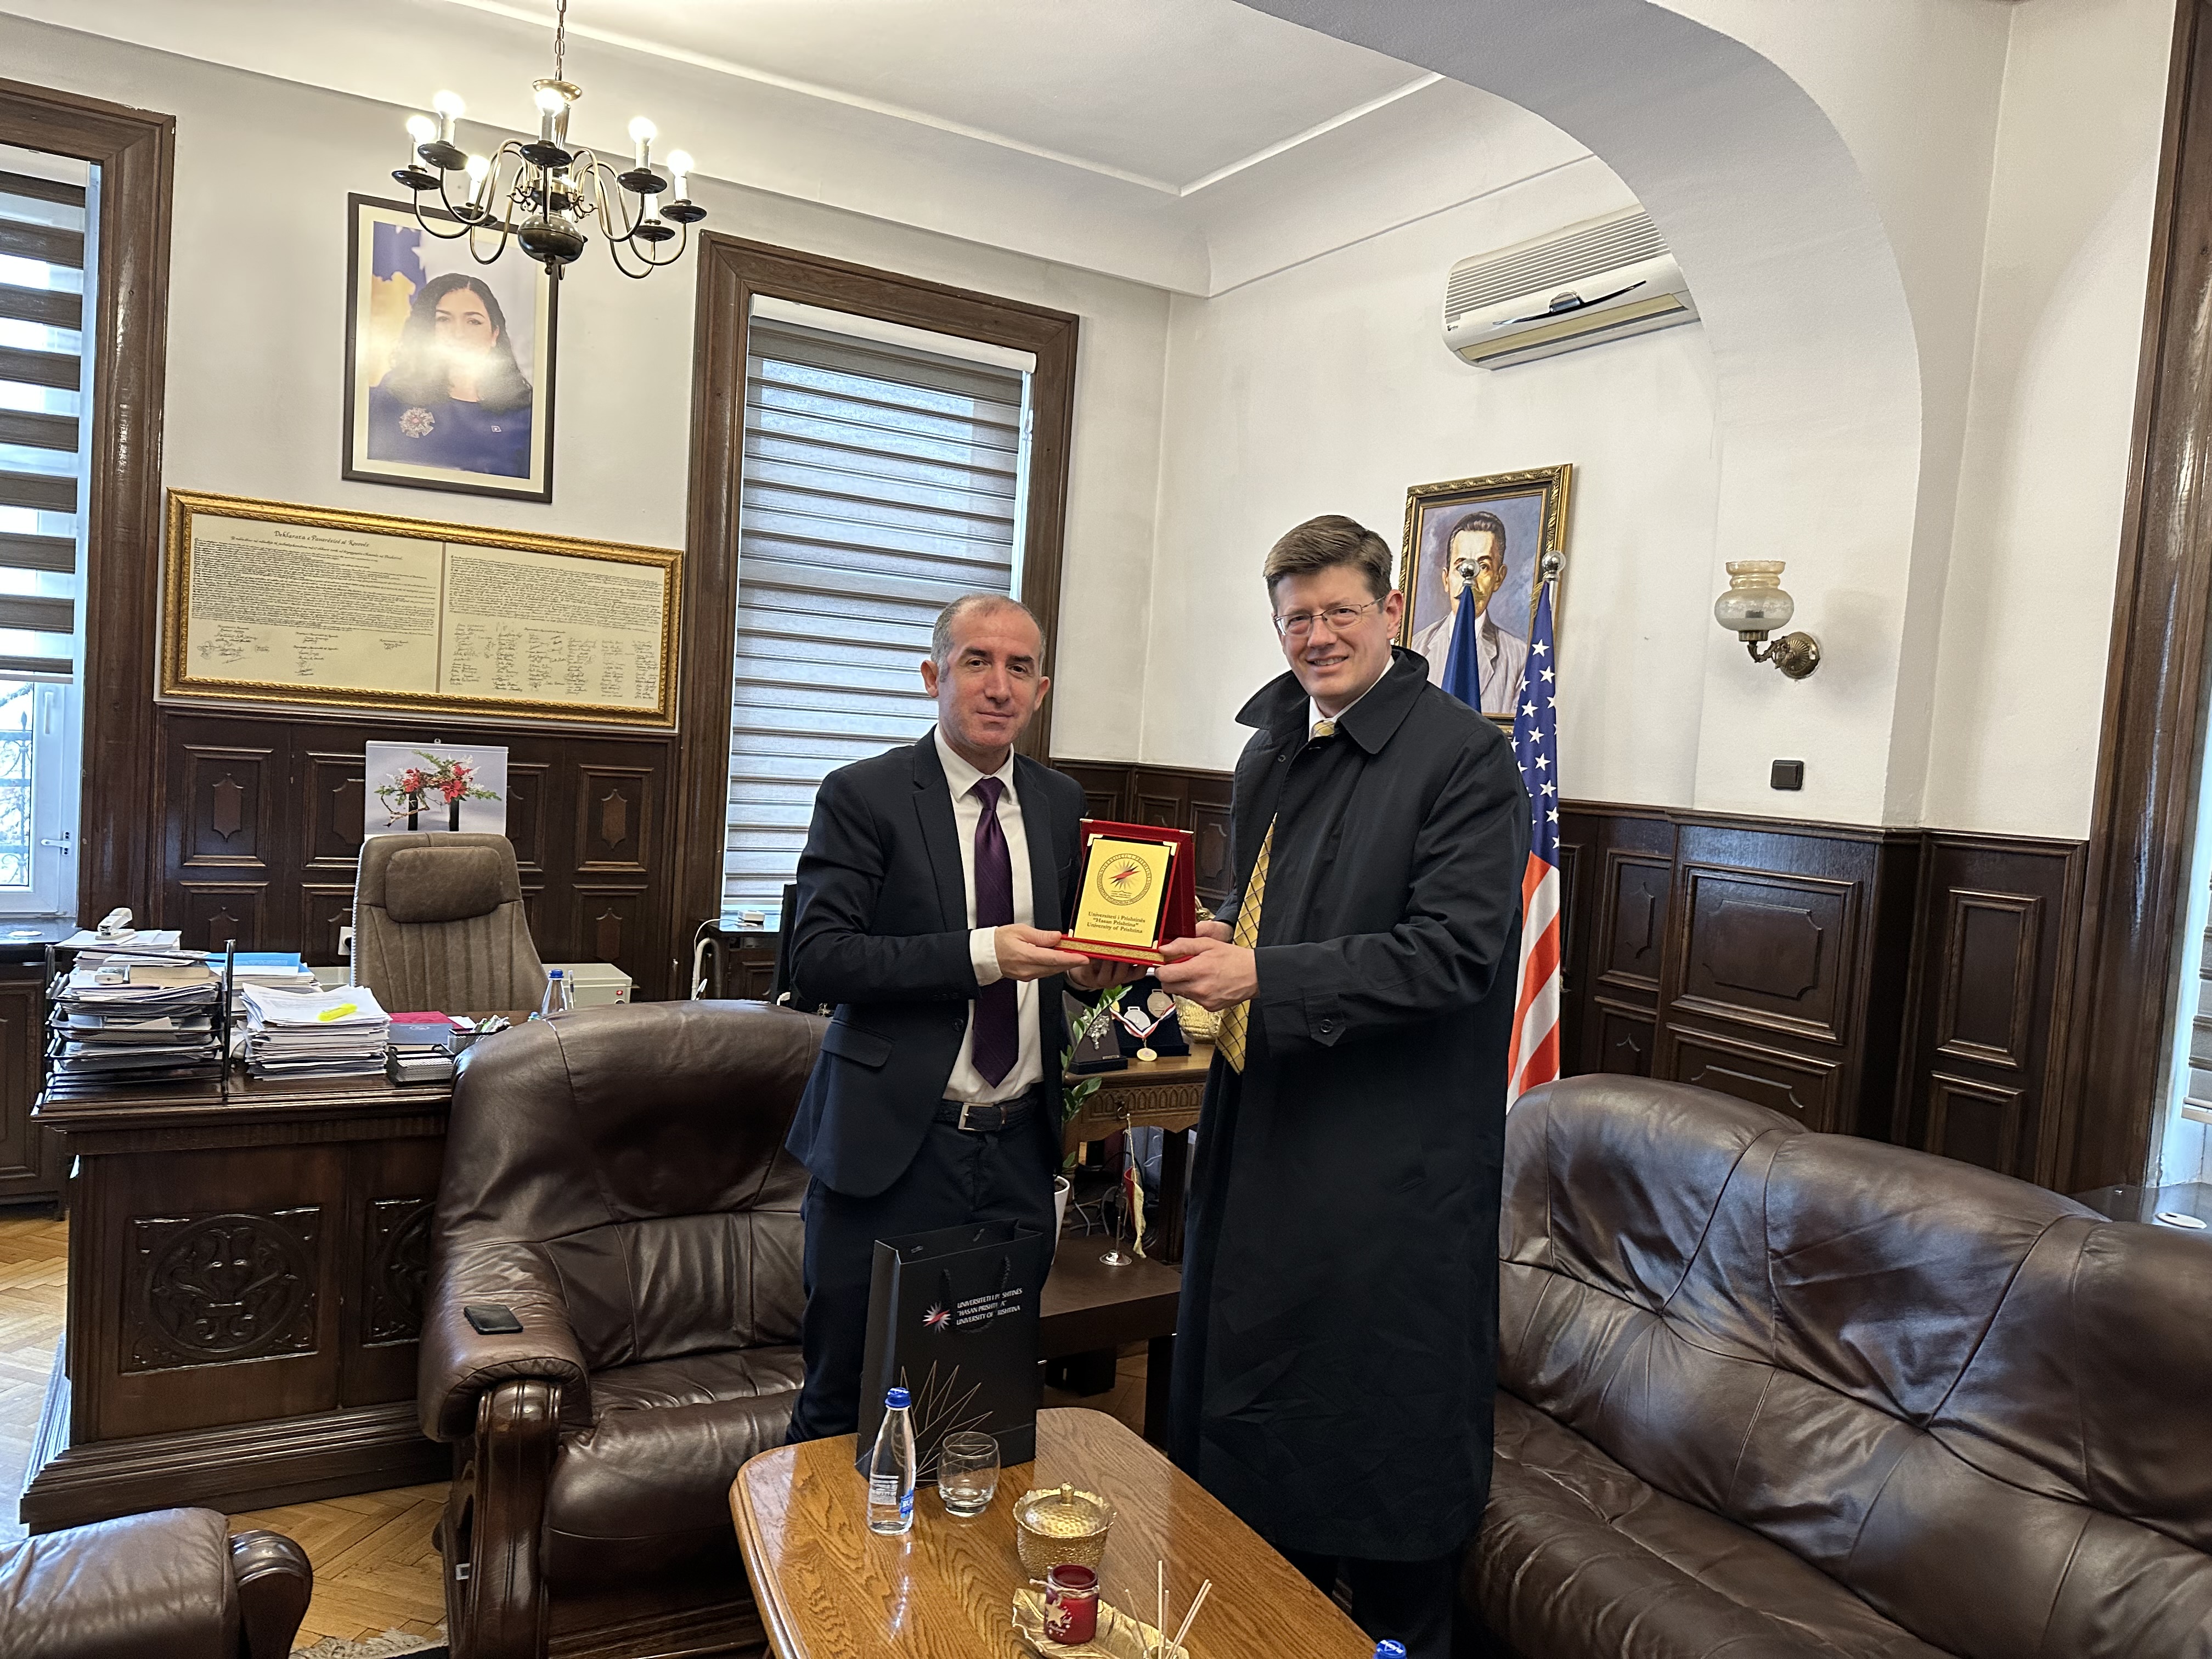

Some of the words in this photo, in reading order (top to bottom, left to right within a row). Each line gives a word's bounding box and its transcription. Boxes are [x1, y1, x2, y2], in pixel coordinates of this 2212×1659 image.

[274, 531, 306, 540] Deklarata
[1088, 911, 1116, 919] Universiteti
[1087, 922, 1112, 930] University
[956, 1313, 986, 1325] UNIVERSITY
